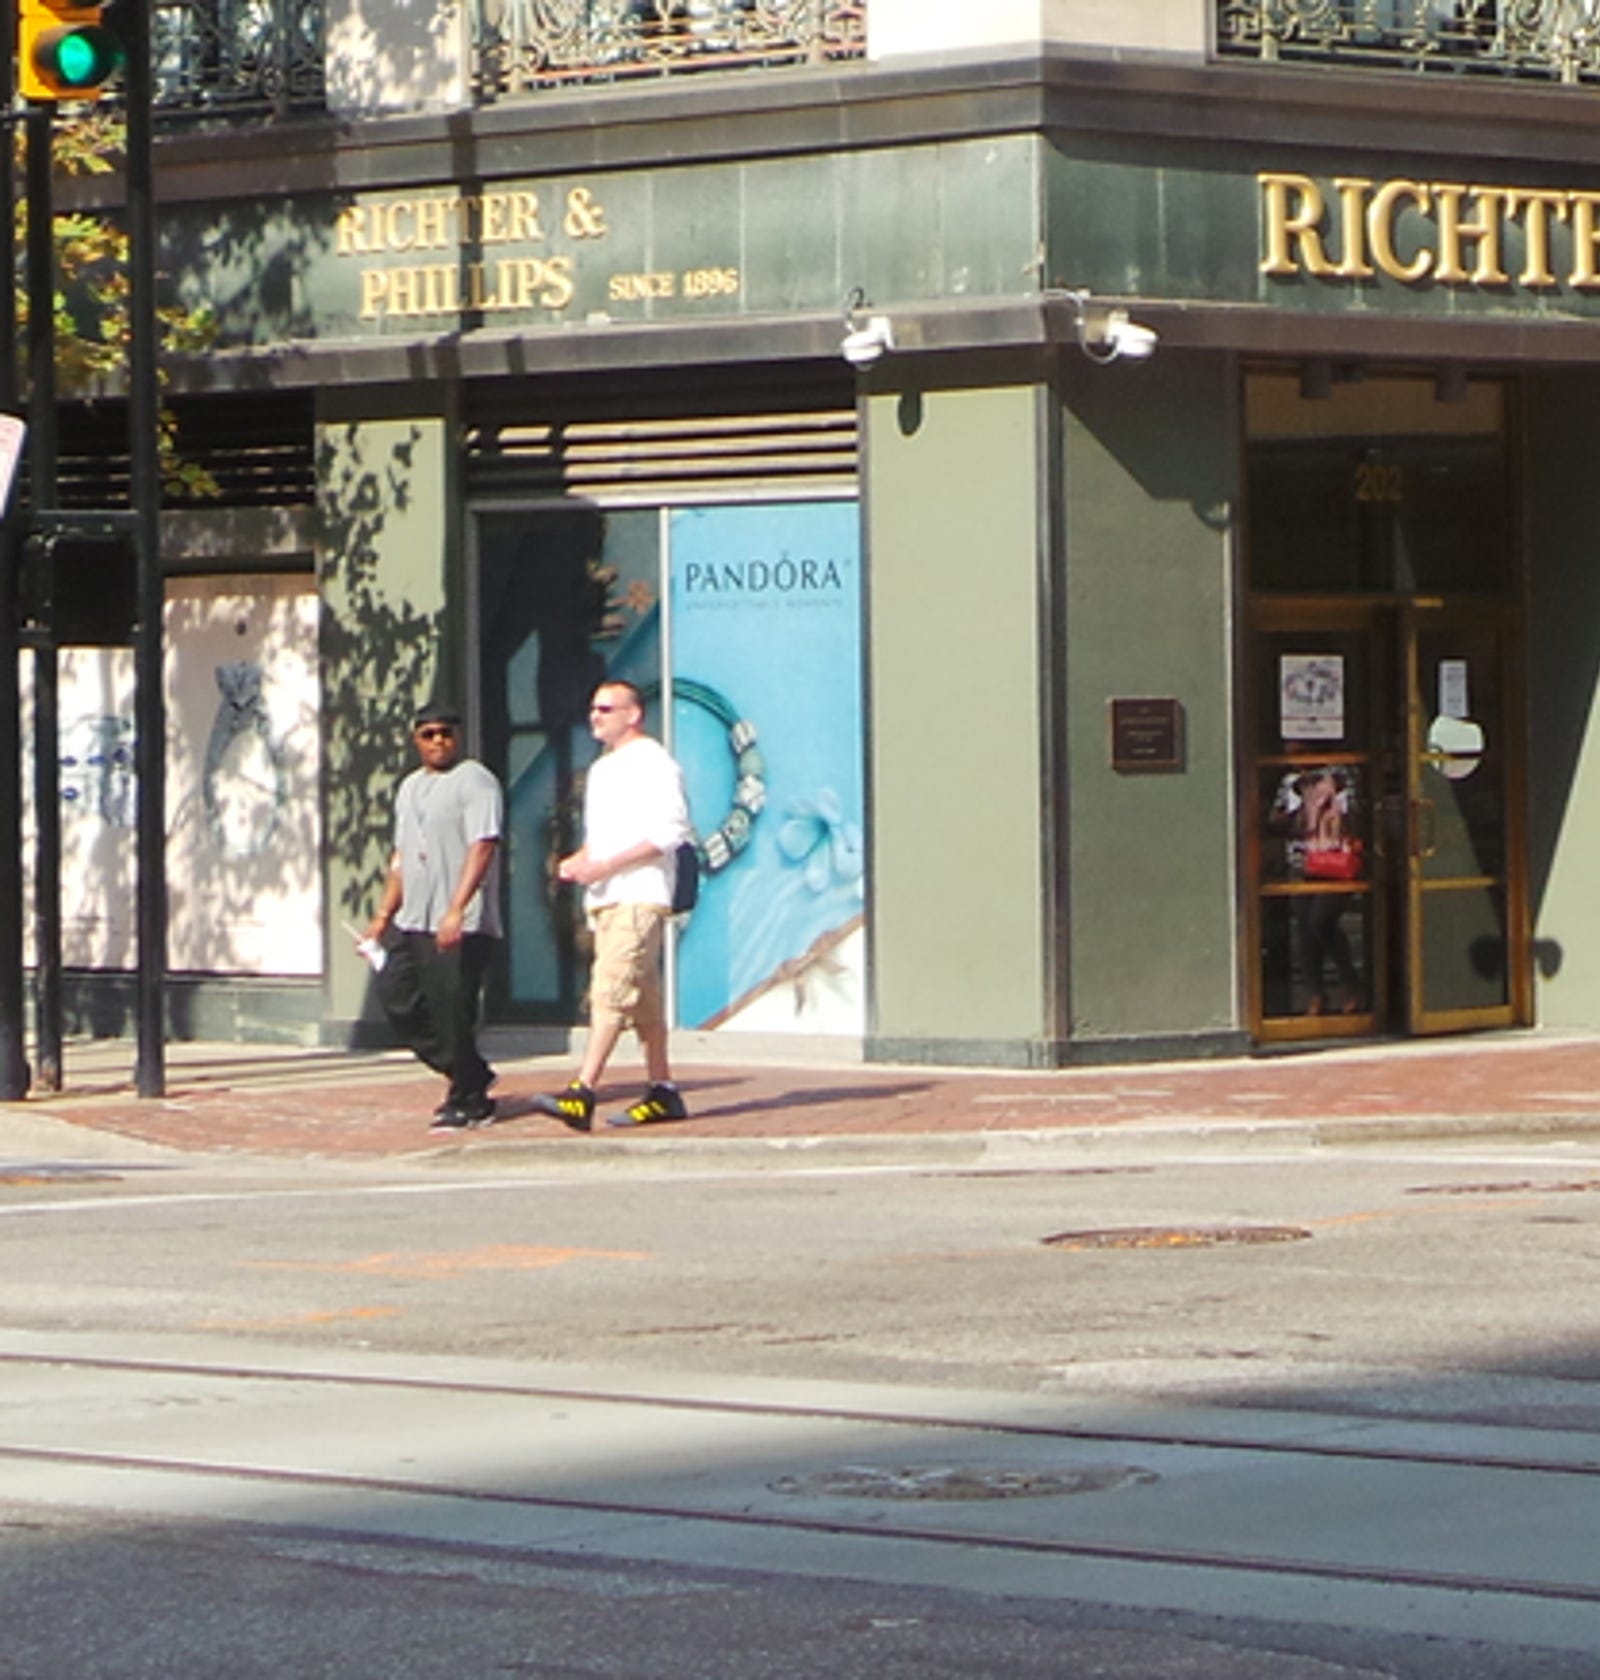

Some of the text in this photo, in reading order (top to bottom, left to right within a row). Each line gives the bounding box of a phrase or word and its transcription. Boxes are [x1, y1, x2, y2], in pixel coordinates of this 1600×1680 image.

[336, 186, 608, 256] RICHTER &
[359, 255, 739, 321] PHILLIPS SINCE 1896
[1354, 463, 1403, 502] 202
